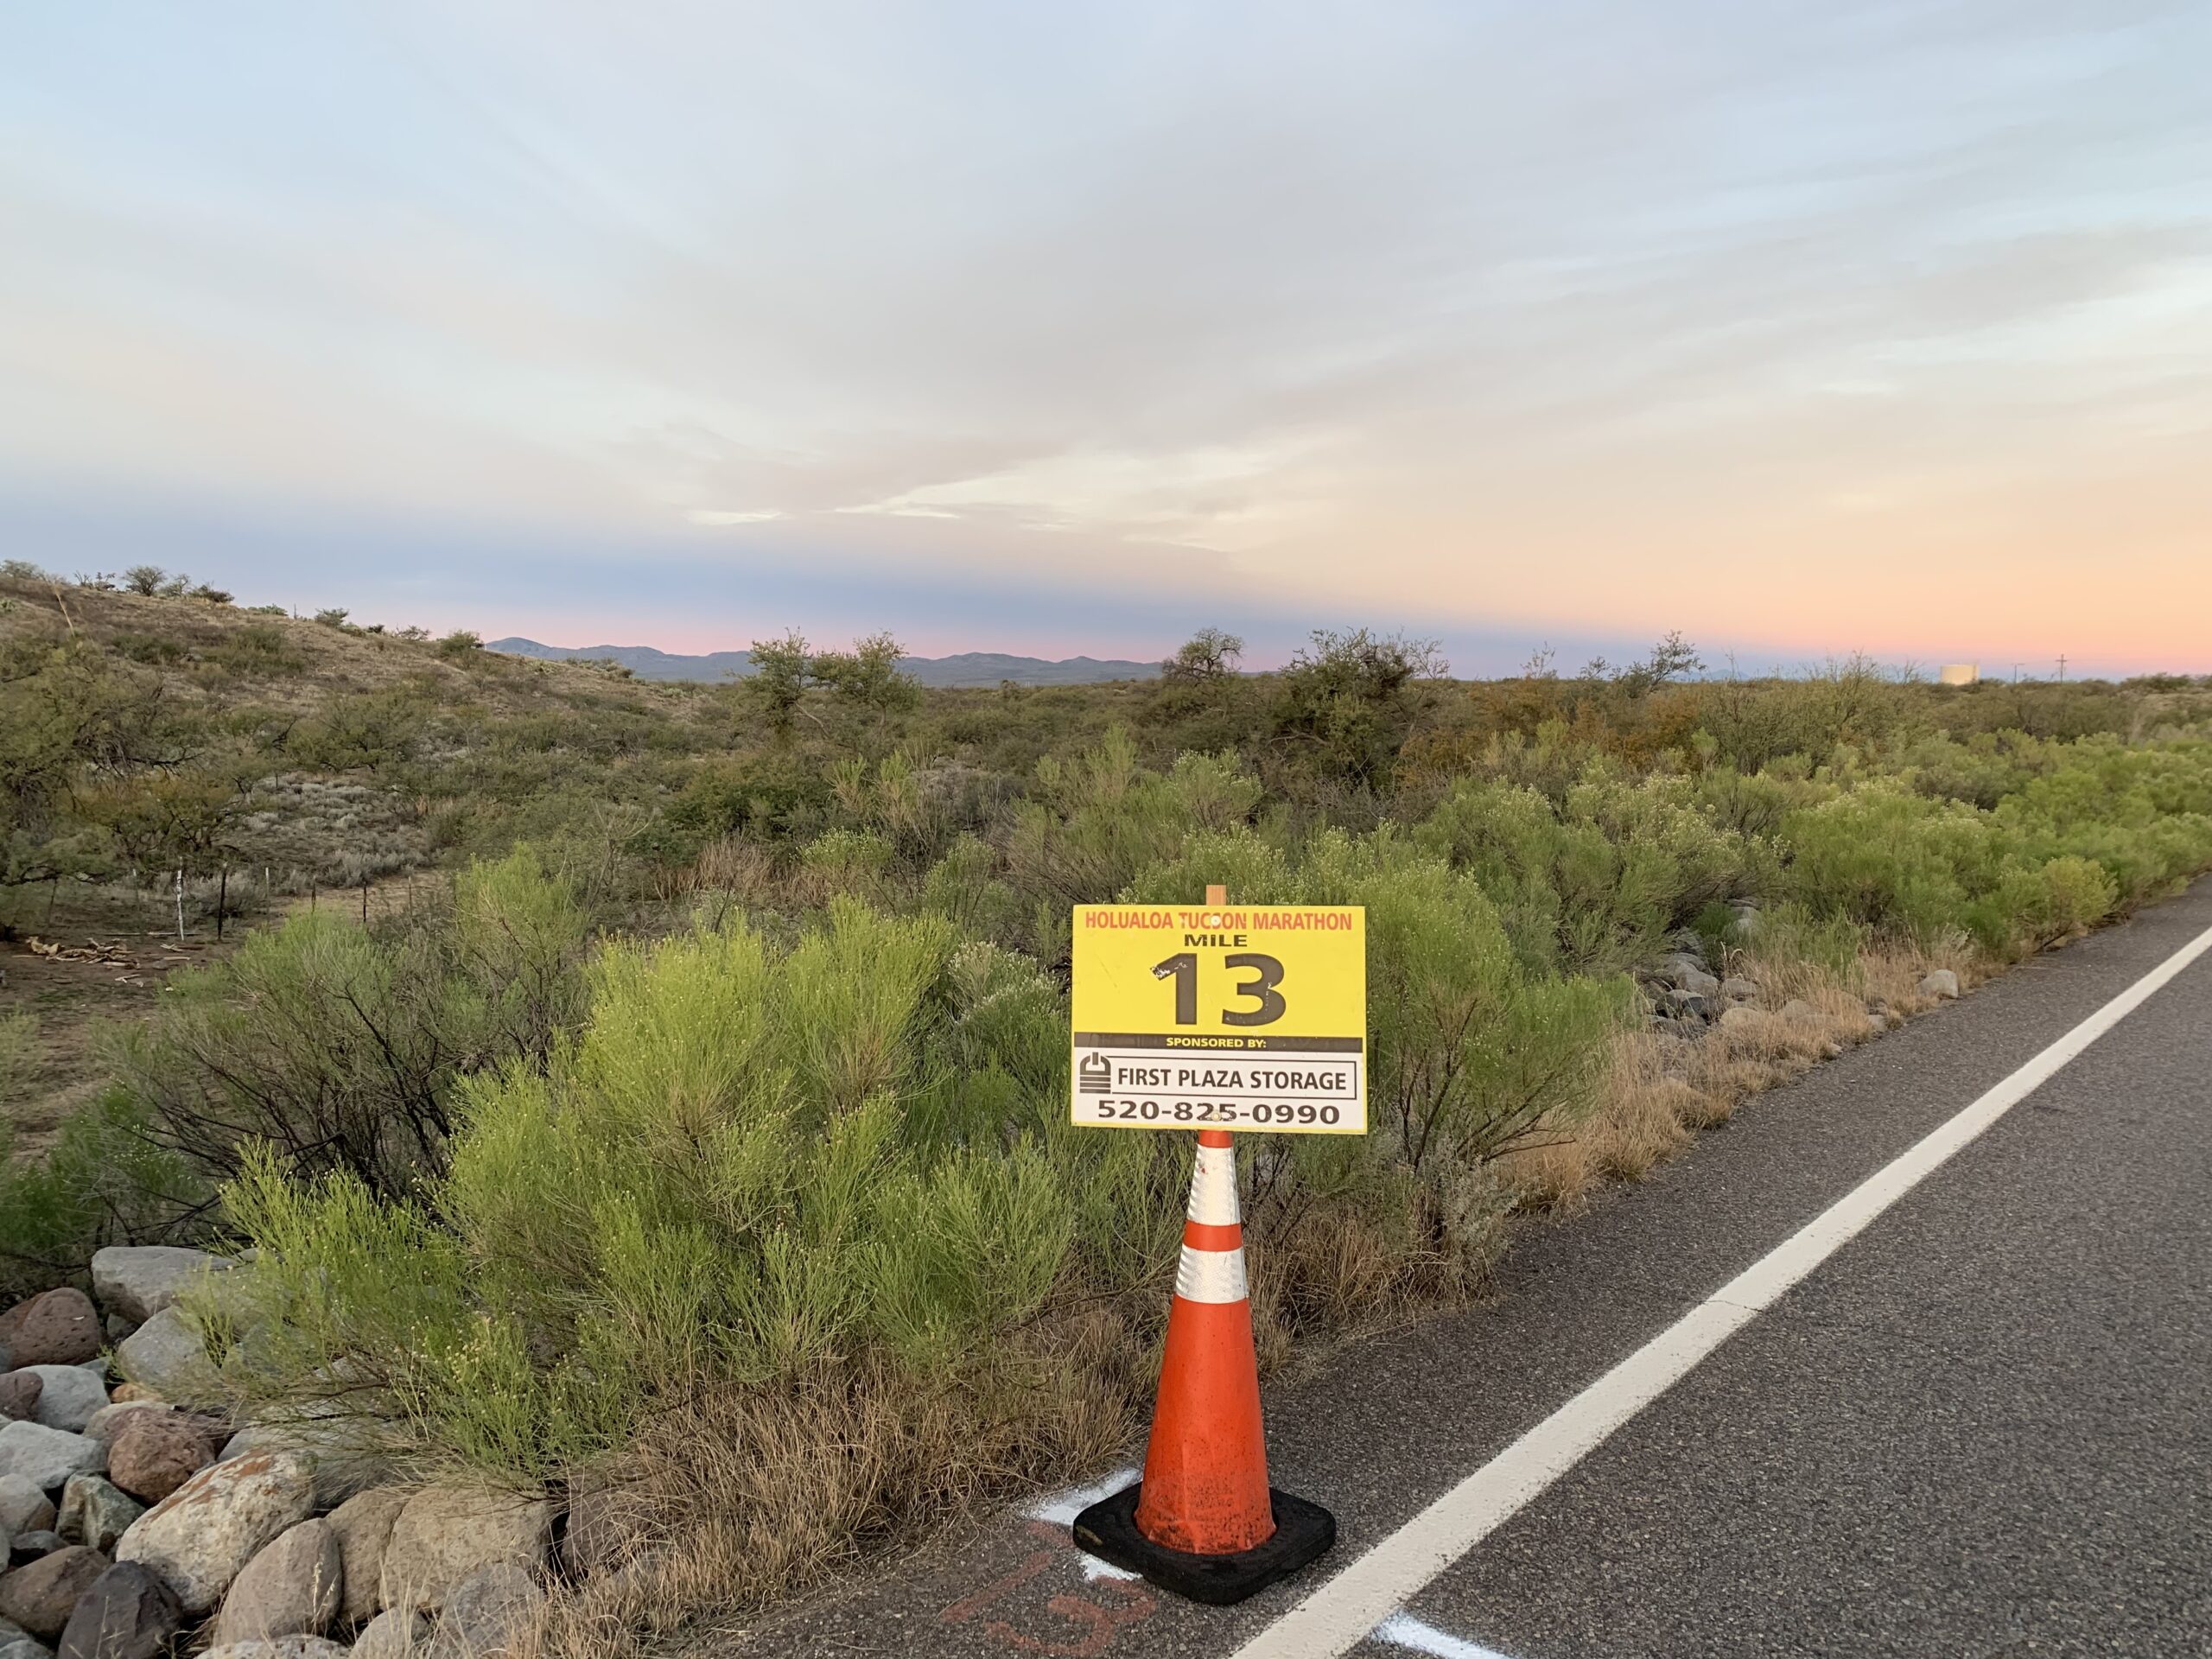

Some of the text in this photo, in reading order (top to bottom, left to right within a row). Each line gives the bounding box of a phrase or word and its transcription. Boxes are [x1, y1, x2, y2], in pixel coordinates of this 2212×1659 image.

[1085, 911, 1173, 929] HOLUALOA
[1253, 912, 1352, 931] MARATHON
[1184, 934, 1248, 947] MILE
[1149, 952, 1287, 1027] 13
[1166, 1037, 1267, 1049] SPONSORED BY:
[1118, 1067, 1346, 1090] FIRST PLAZA STORAGE
[1097, 1100, 1340, 1124] 520-825-0990
